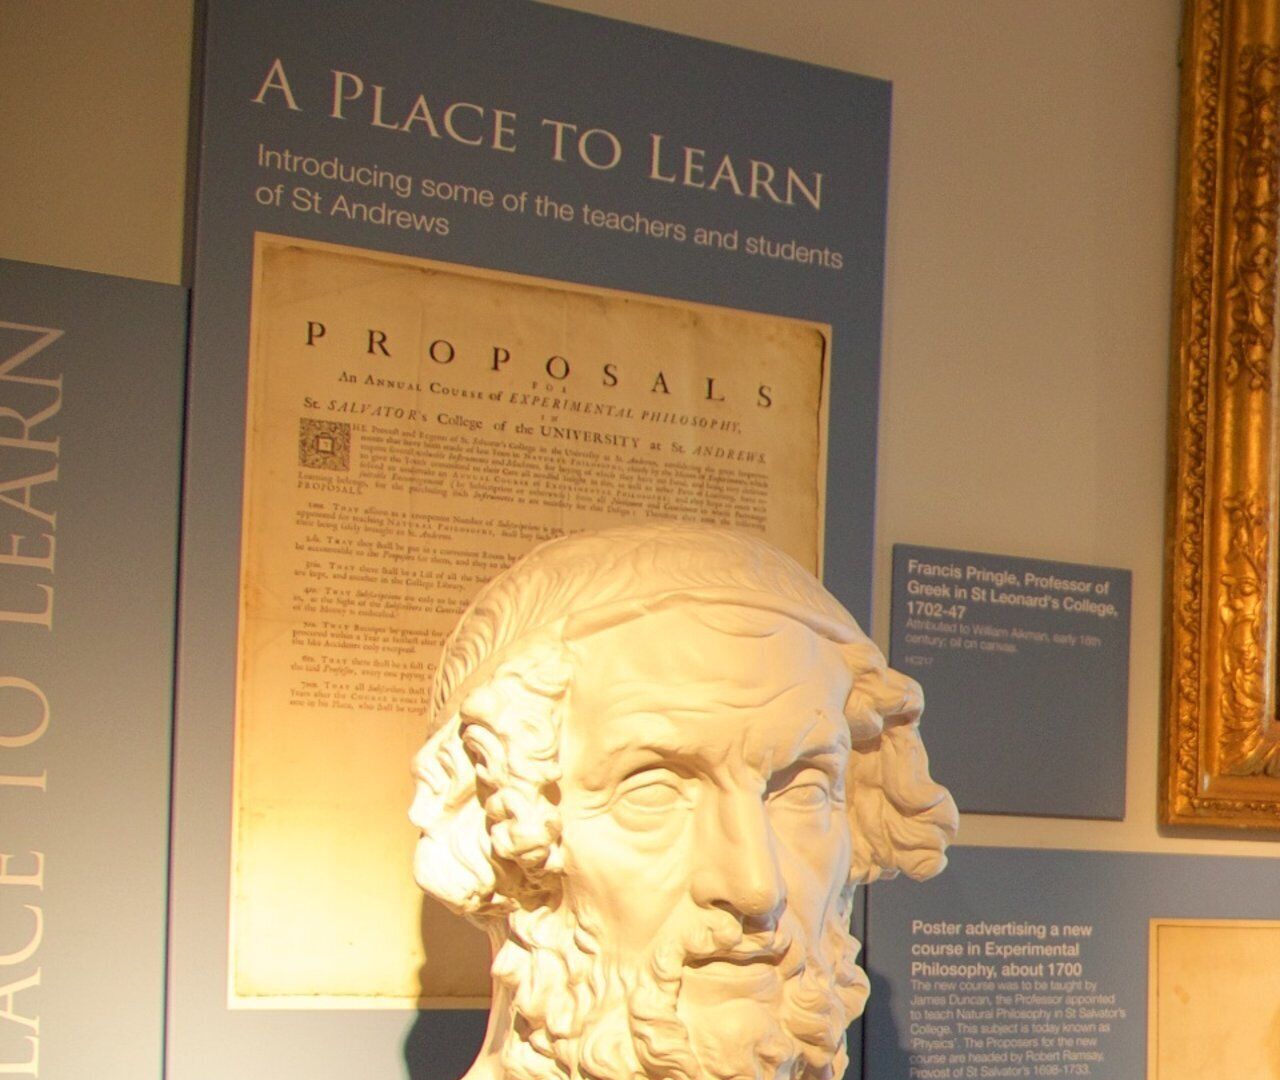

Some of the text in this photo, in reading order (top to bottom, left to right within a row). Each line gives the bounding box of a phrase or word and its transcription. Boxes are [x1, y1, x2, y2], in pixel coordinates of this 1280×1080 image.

[252, 58, 823, 211] A PLACE TO LEARN
[255, 184, 450, 236] of St Andrews
[258, 143, 844, 270] Introducing some of the teachers and students
[305, 320, 773, 409] PROPOSALS
[339, 371, 357, 384] An
[488, 391, 503, 402] of
[509, 392, 634, 420] EXPERIMENTAL
[437, 412, 483, 430] College
[494, 420, 506, 432] of
[515, 422, 534, 435] the
[540, 425, 641, 450] UNIVERSITY
[650, 439, 661, 451] at
[908, 558, 1110, 595] Francis Pringle, Professor of
[907, 580, 1119, 617] Greek in St Leonard's College,
[907, 600, 967, 620] 1702-47
[906, 617, 1009, 638] Attributed to William
[911, 919, 1092, 940] Poster advertising a new
[911, 941, 1080, 959] course in Experimental
[911, 961, 1083, 980] Philosophy, about 1700
[911, 978, 1097, 993] The new course was to be taught by
[911, 994, 946, 1005] James
[995, 993, 1011, 1005] the
[1014, 993, 1062, 1005] Professor
[1065, 993, 1115, 1007] appointed
[910, 1008, 1077, 1022] to teach Natural Philosophy in St
[957, 1022, 1110, 1035] This subject is today known as
[965, 1037, 983, 1048] The
[1057, 1036, 1073, 1047] the
[1076, 1038, 1097, 1047] new
[910, 1050, 1061, 1064] course are headed by Robert
[910, 1066, 978, 1079] Provost of St
